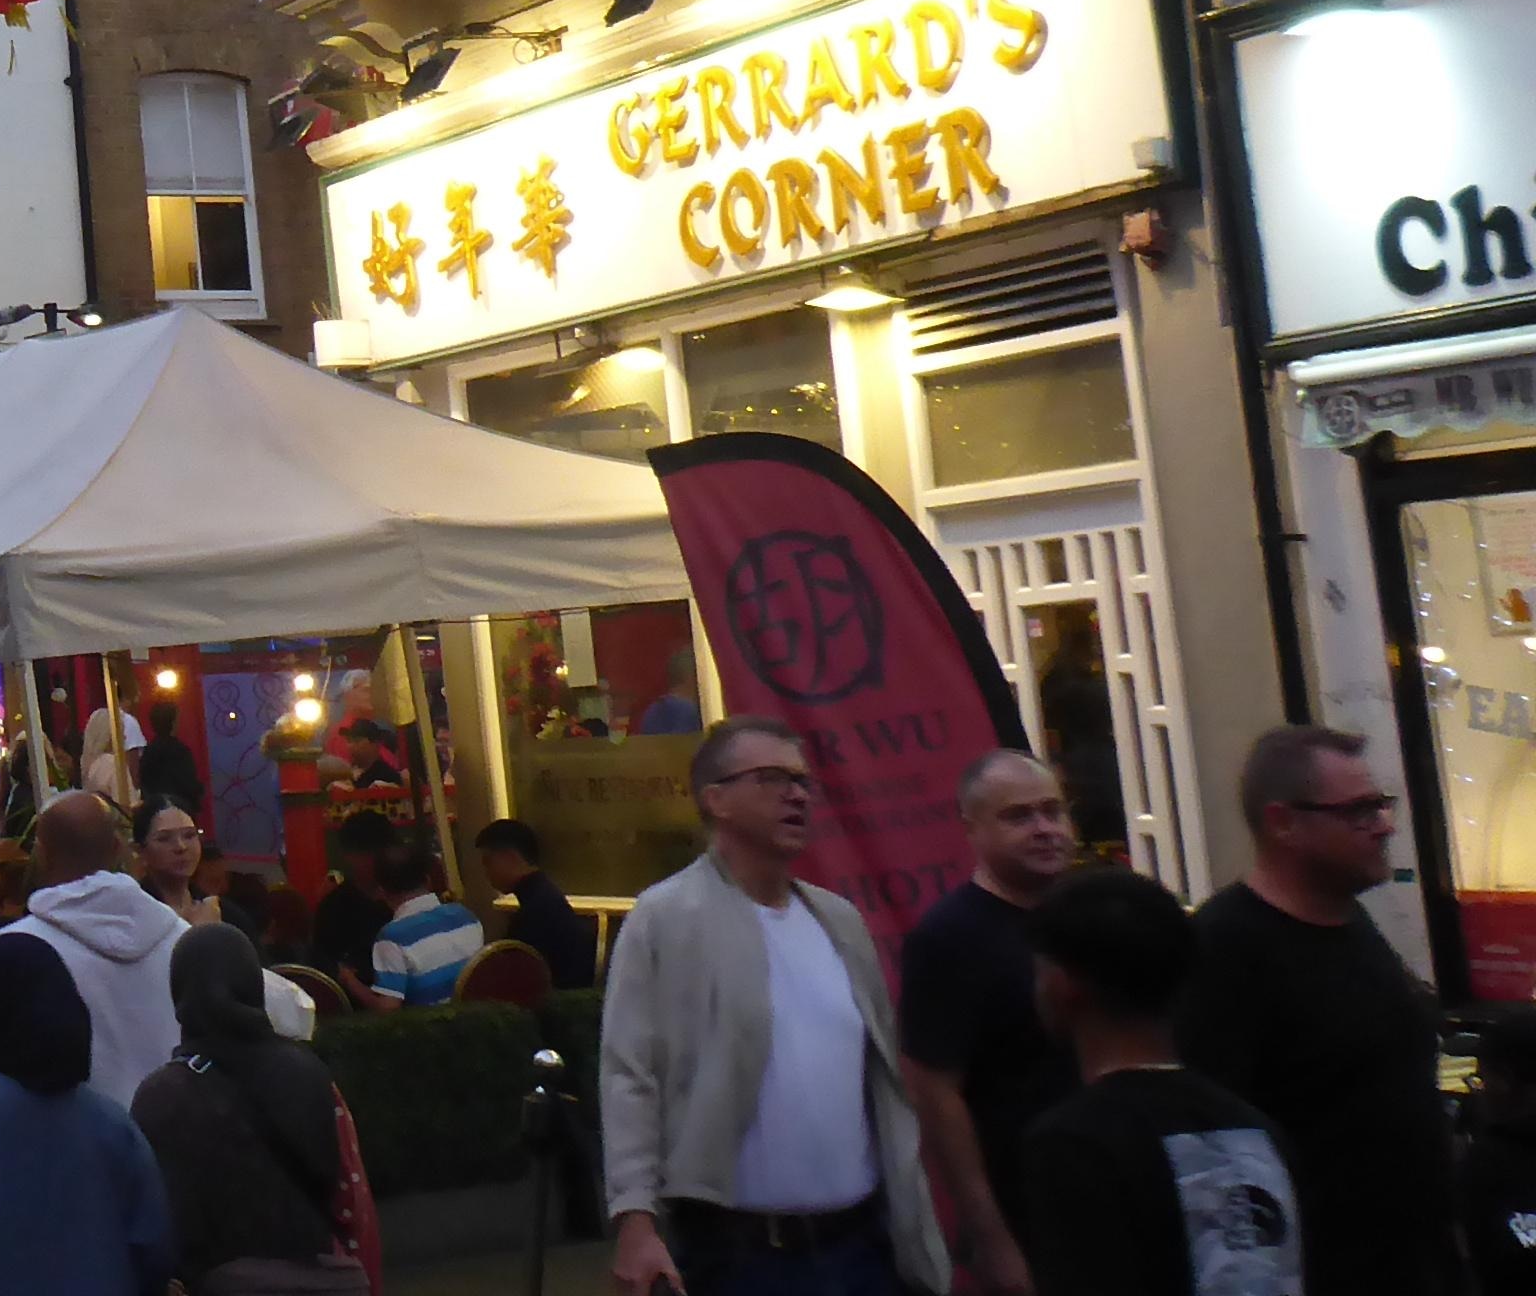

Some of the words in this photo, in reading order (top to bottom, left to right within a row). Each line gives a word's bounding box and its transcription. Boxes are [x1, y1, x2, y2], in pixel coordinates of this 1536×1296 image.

[362, 153, 574, 310] 好年華
[677, 108, 1005, 269] CORNER
[1376, 174, 1536, 296] Ch
[854, 709, 953, 759] WU
